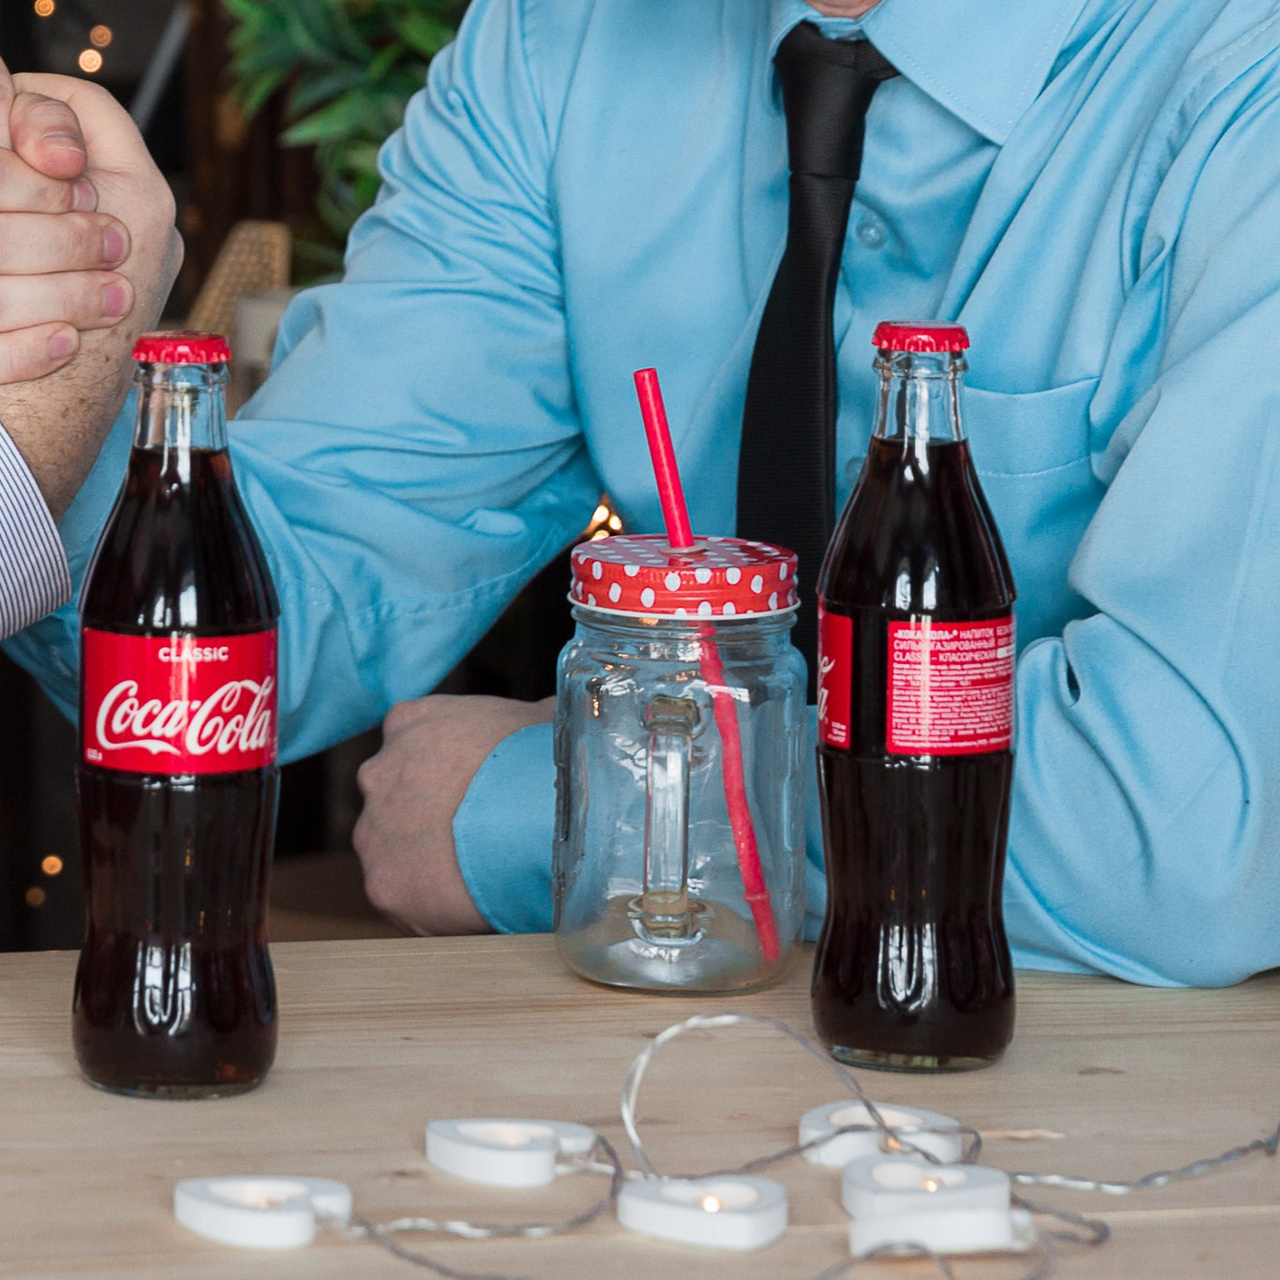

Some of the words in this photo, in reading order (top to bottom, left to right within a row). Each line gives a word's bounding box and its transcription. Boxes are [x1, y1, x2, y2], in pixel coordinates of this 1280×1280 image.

[893, 637, 996, 651] СИЛЬНГАЗИРОВАННЫЙ
[158, 646, 229, 663] CLASSIC
[96, 676, 274, 756] Coca-Cola
